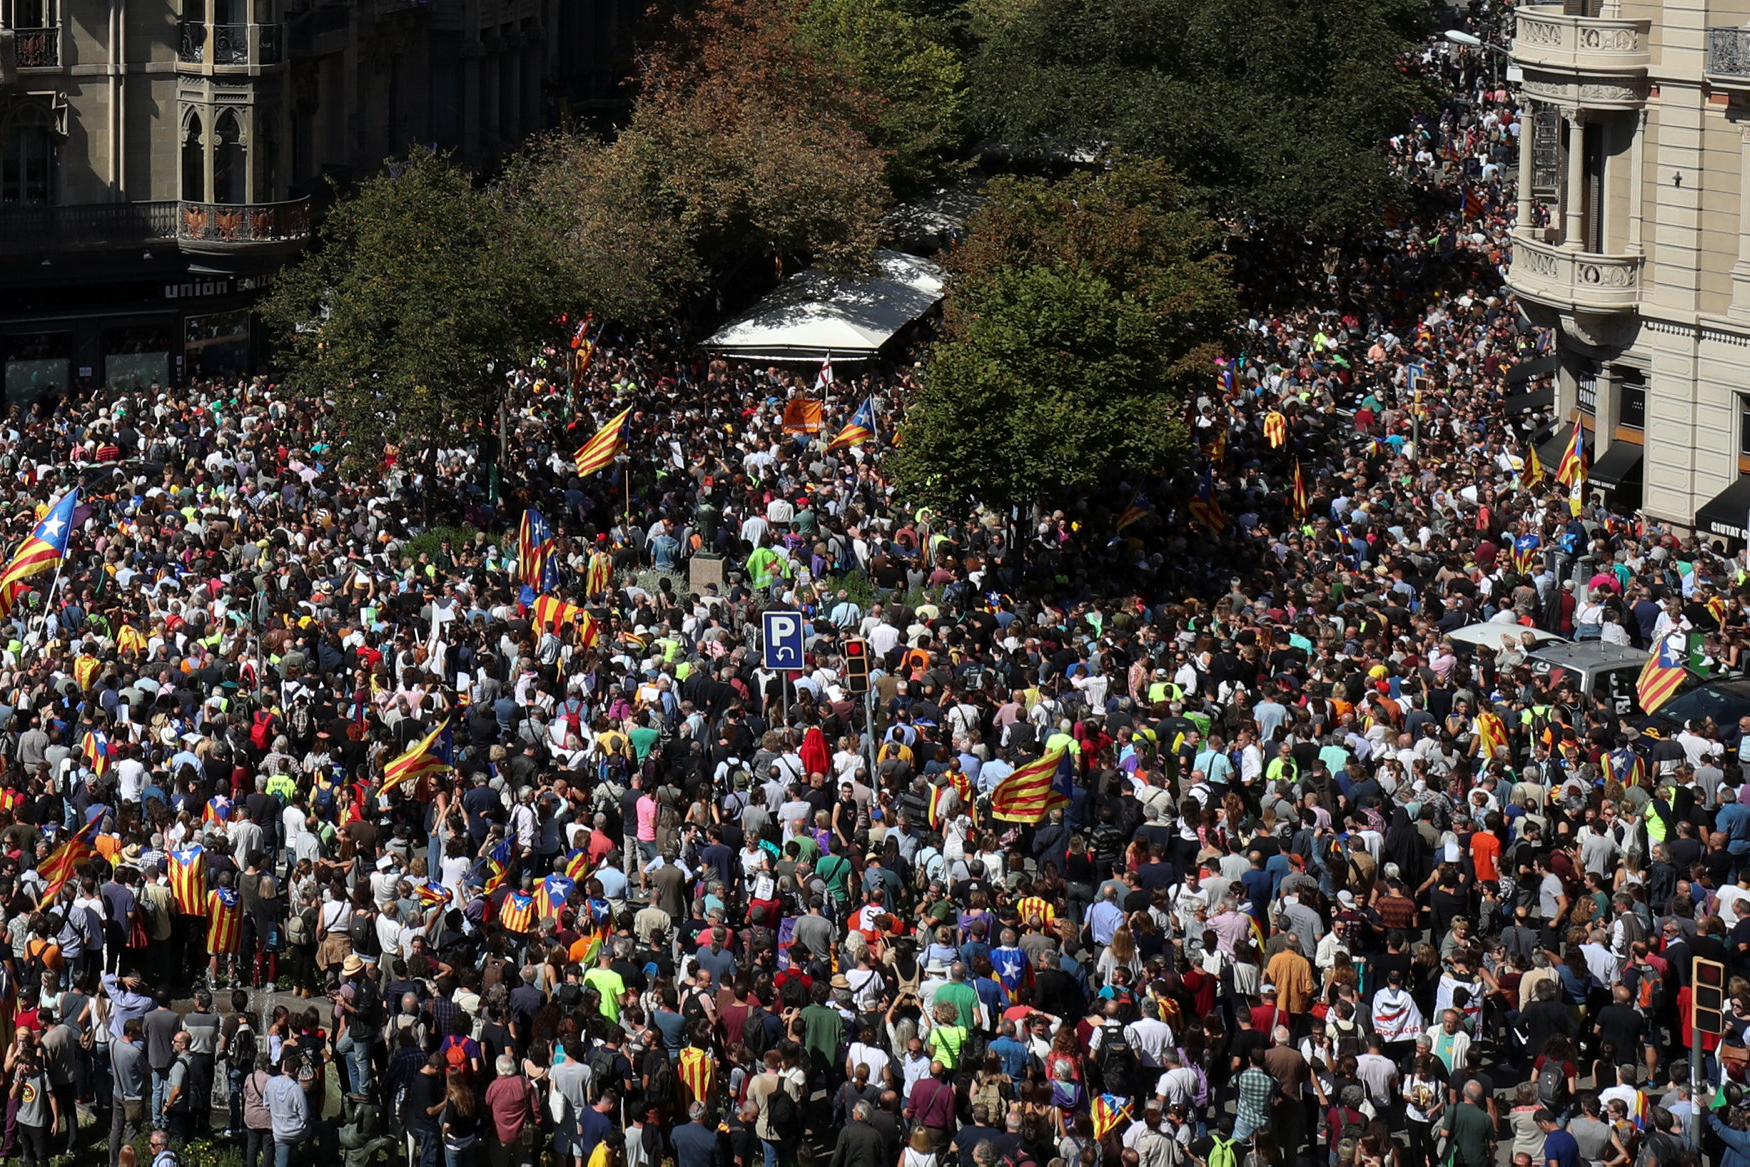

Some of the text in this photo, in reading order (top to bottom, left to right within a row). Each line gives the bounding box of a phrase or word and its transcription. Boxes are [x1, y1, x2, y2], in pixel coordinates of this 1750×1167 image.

[1710, 521, 1748, 540] CIUTAT C
[771, 616, 795, 647] P
